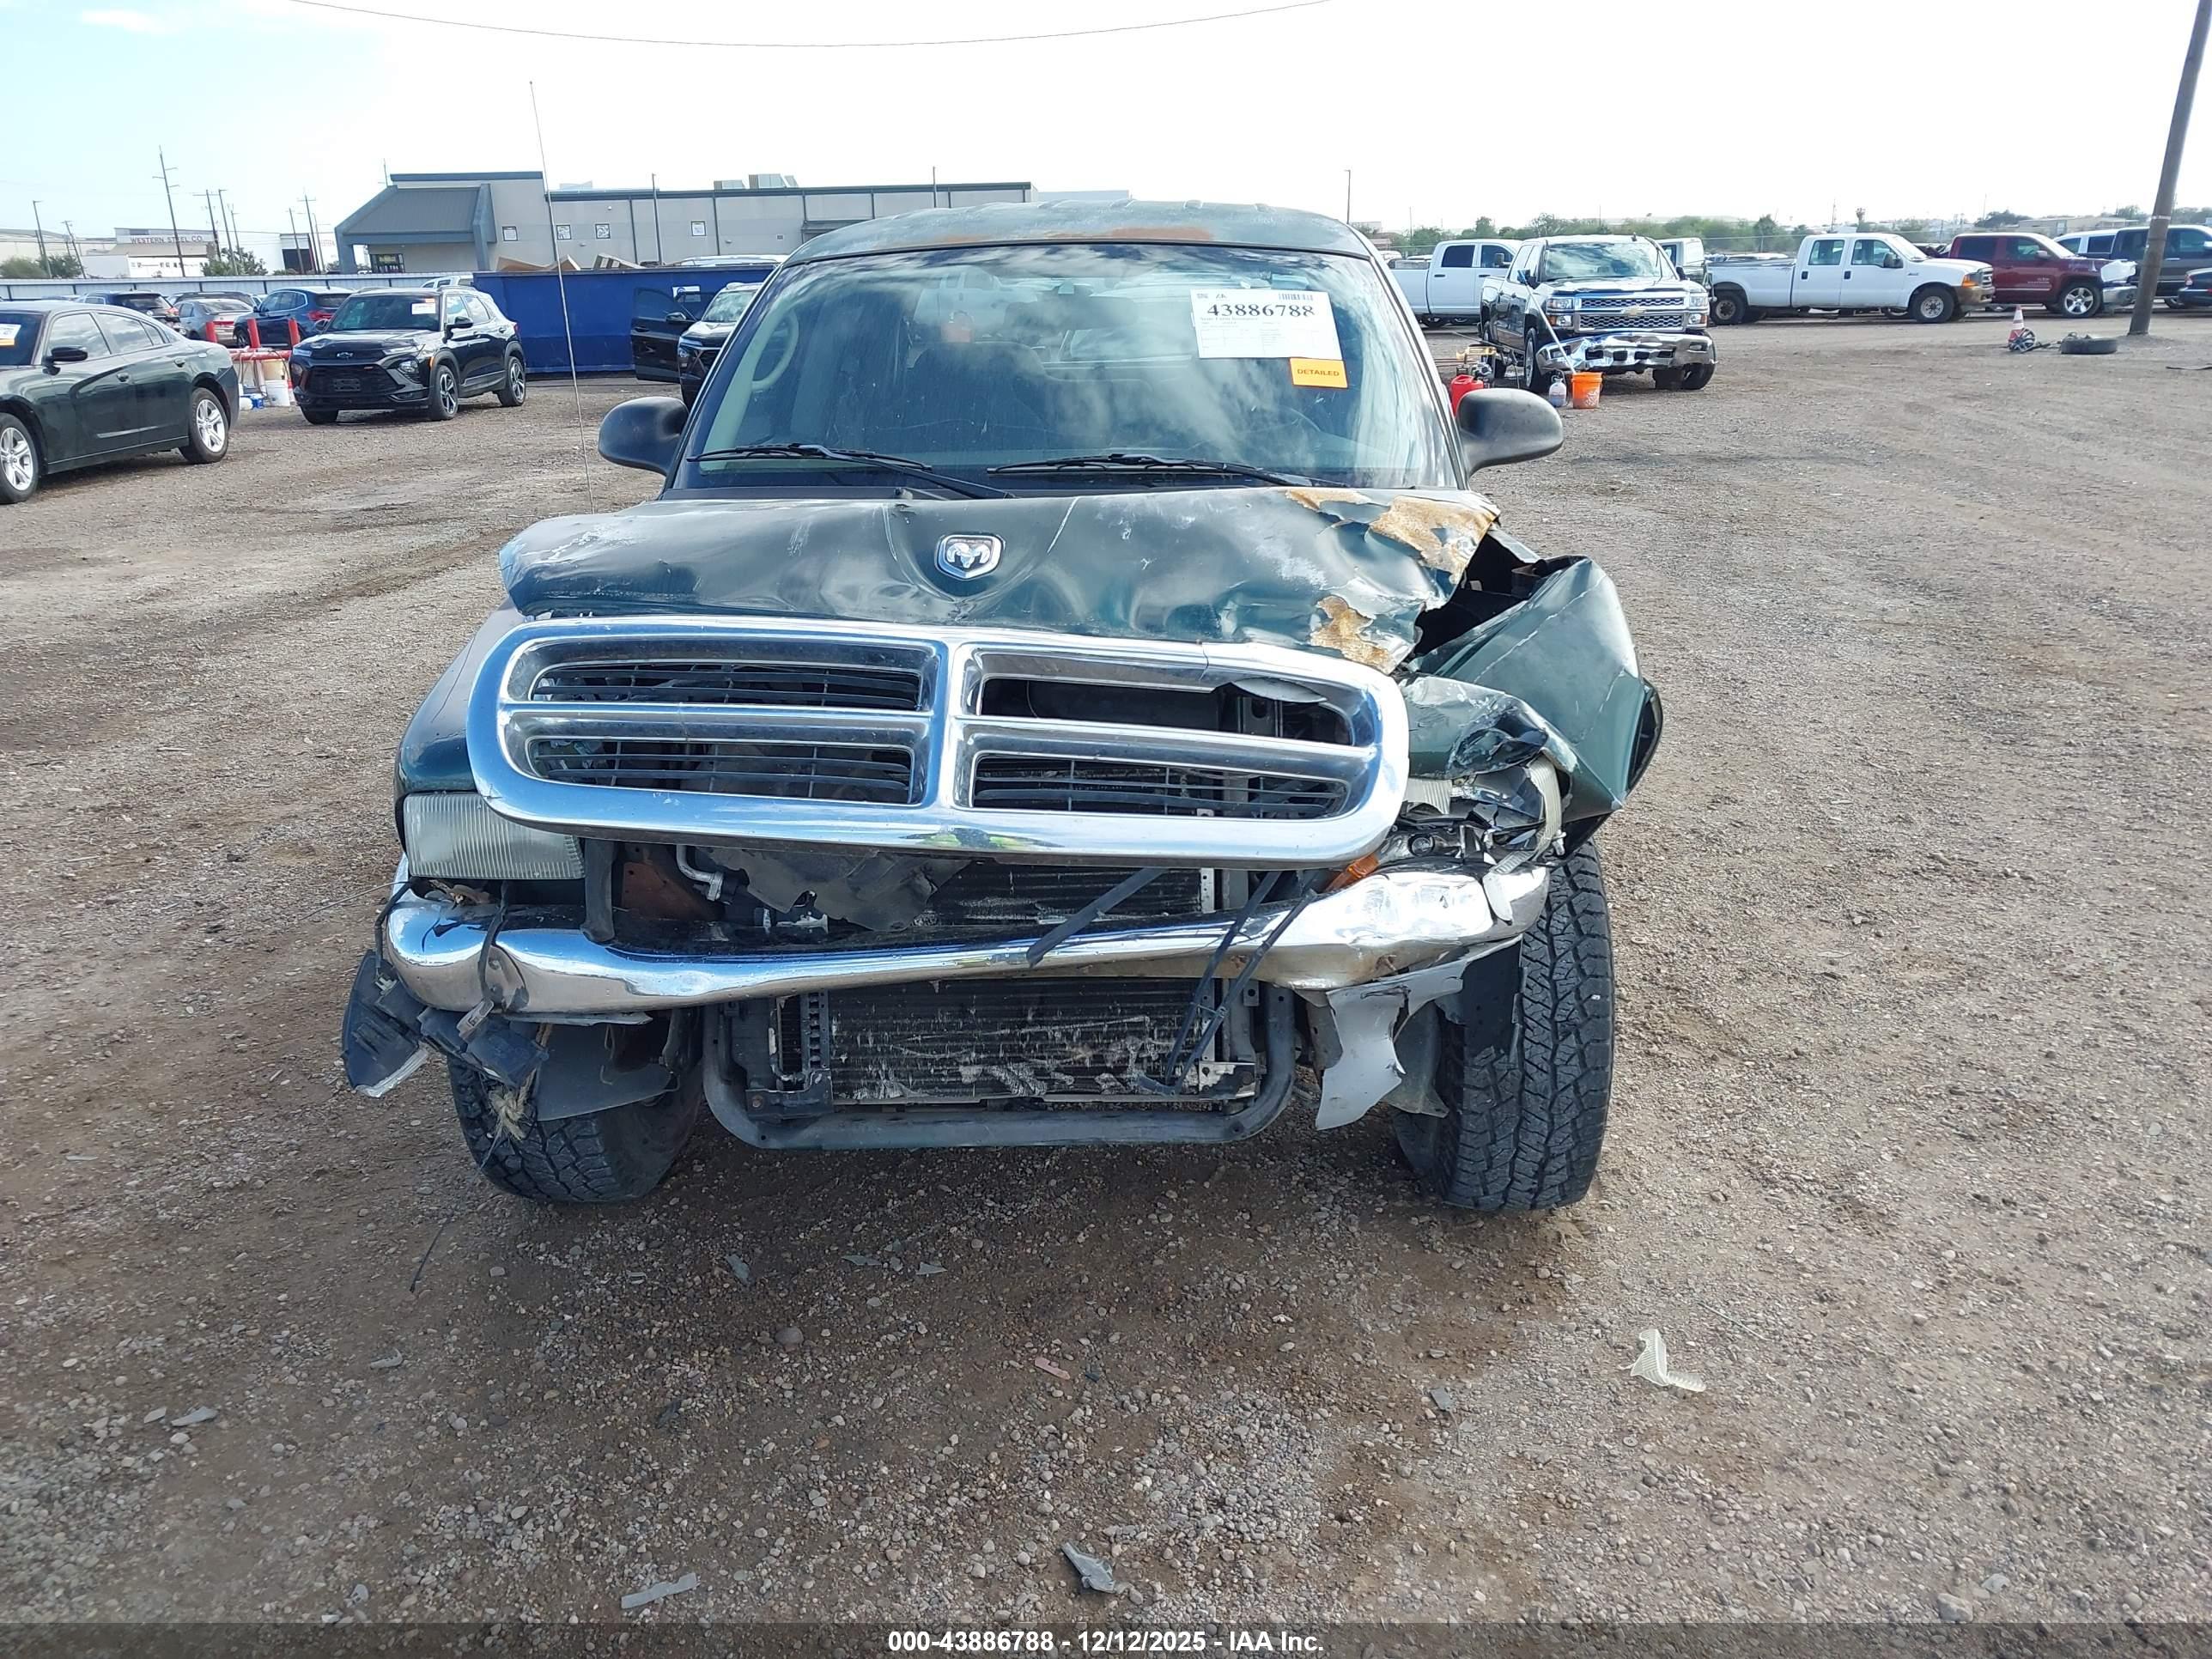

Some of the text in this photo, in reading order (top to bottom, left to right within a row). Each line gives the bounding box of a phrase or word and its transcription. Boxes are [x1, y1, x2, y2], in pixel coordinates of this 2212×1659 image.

[131, 236, 164, 245] WESTERN
[1206, 303, 1316, 317] 43886788
[1297, 368, 1340, 376] DETAILED
